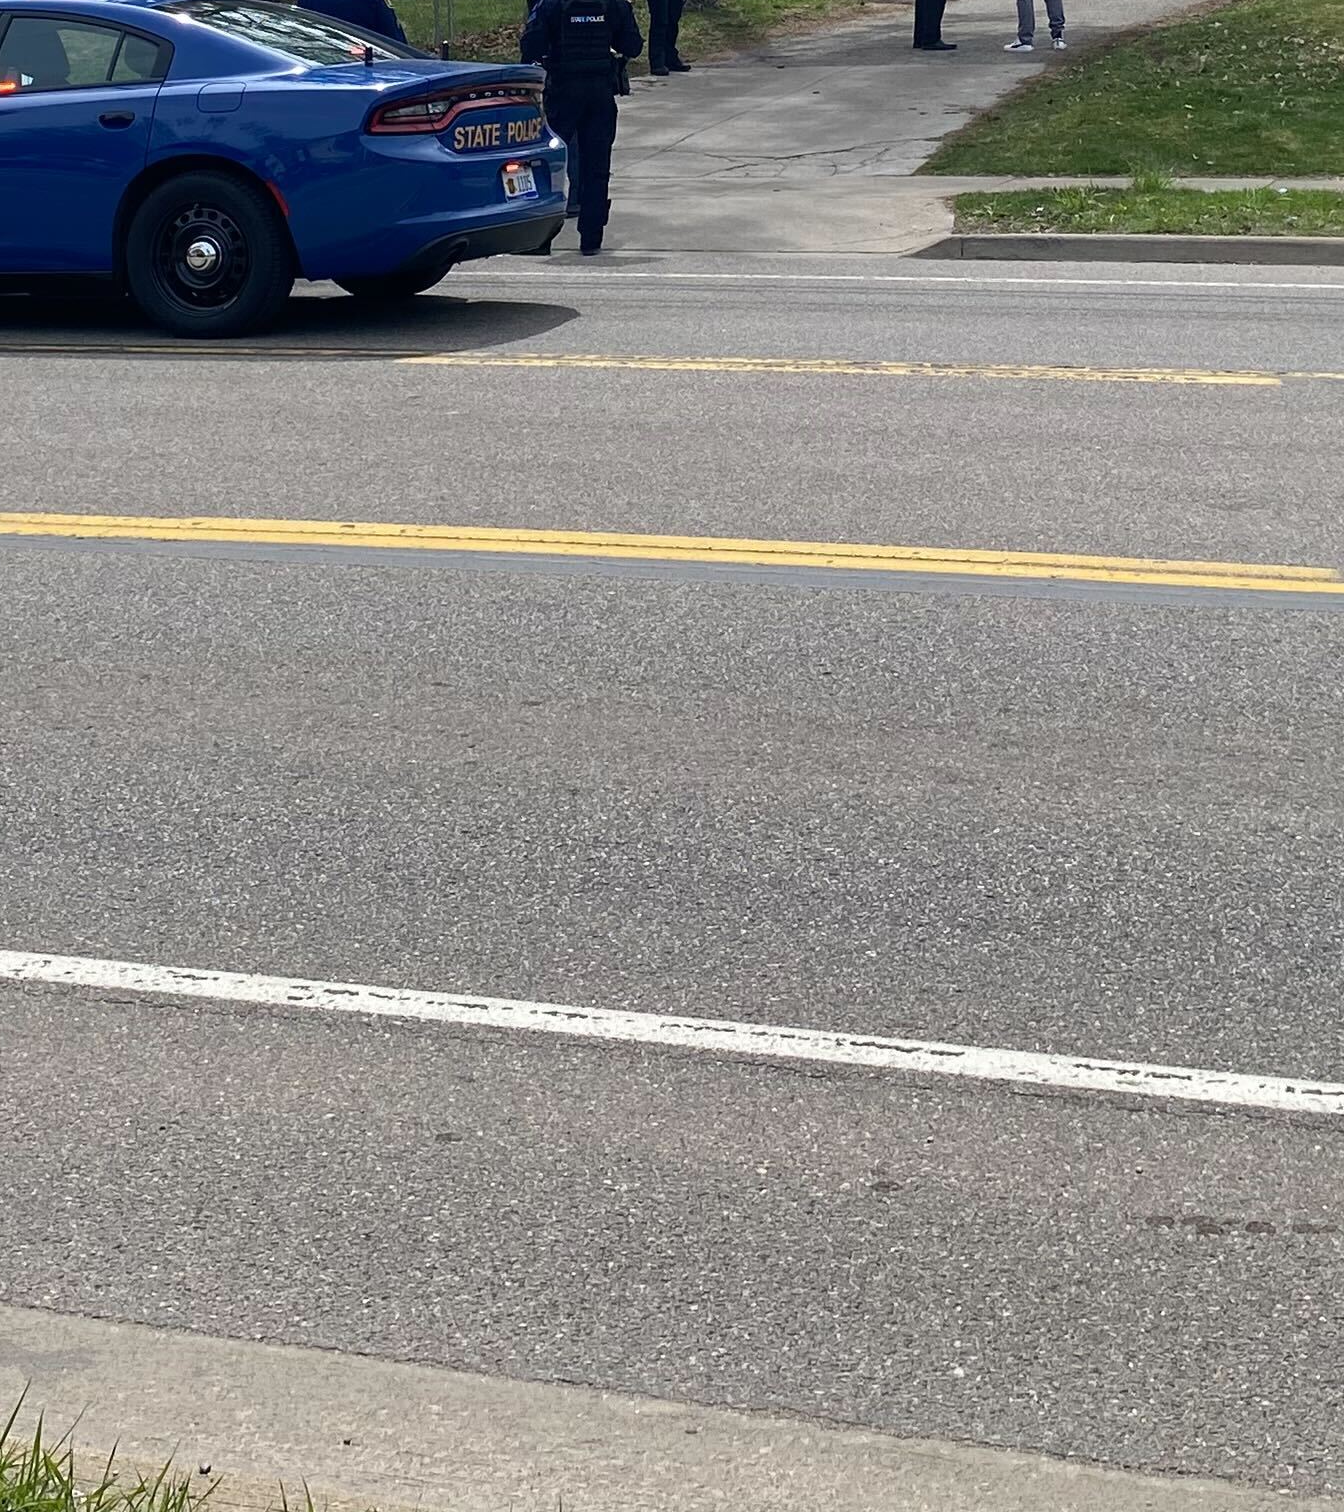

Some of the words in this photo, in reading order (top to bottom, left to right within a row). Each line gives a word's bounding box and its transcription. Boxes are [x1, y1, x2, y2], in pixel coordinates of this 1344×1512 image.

[586, 14, 605, 23] POLICE
[454, 123, 501, 150] STATE
[507, 117, 542, 144] POLICE
